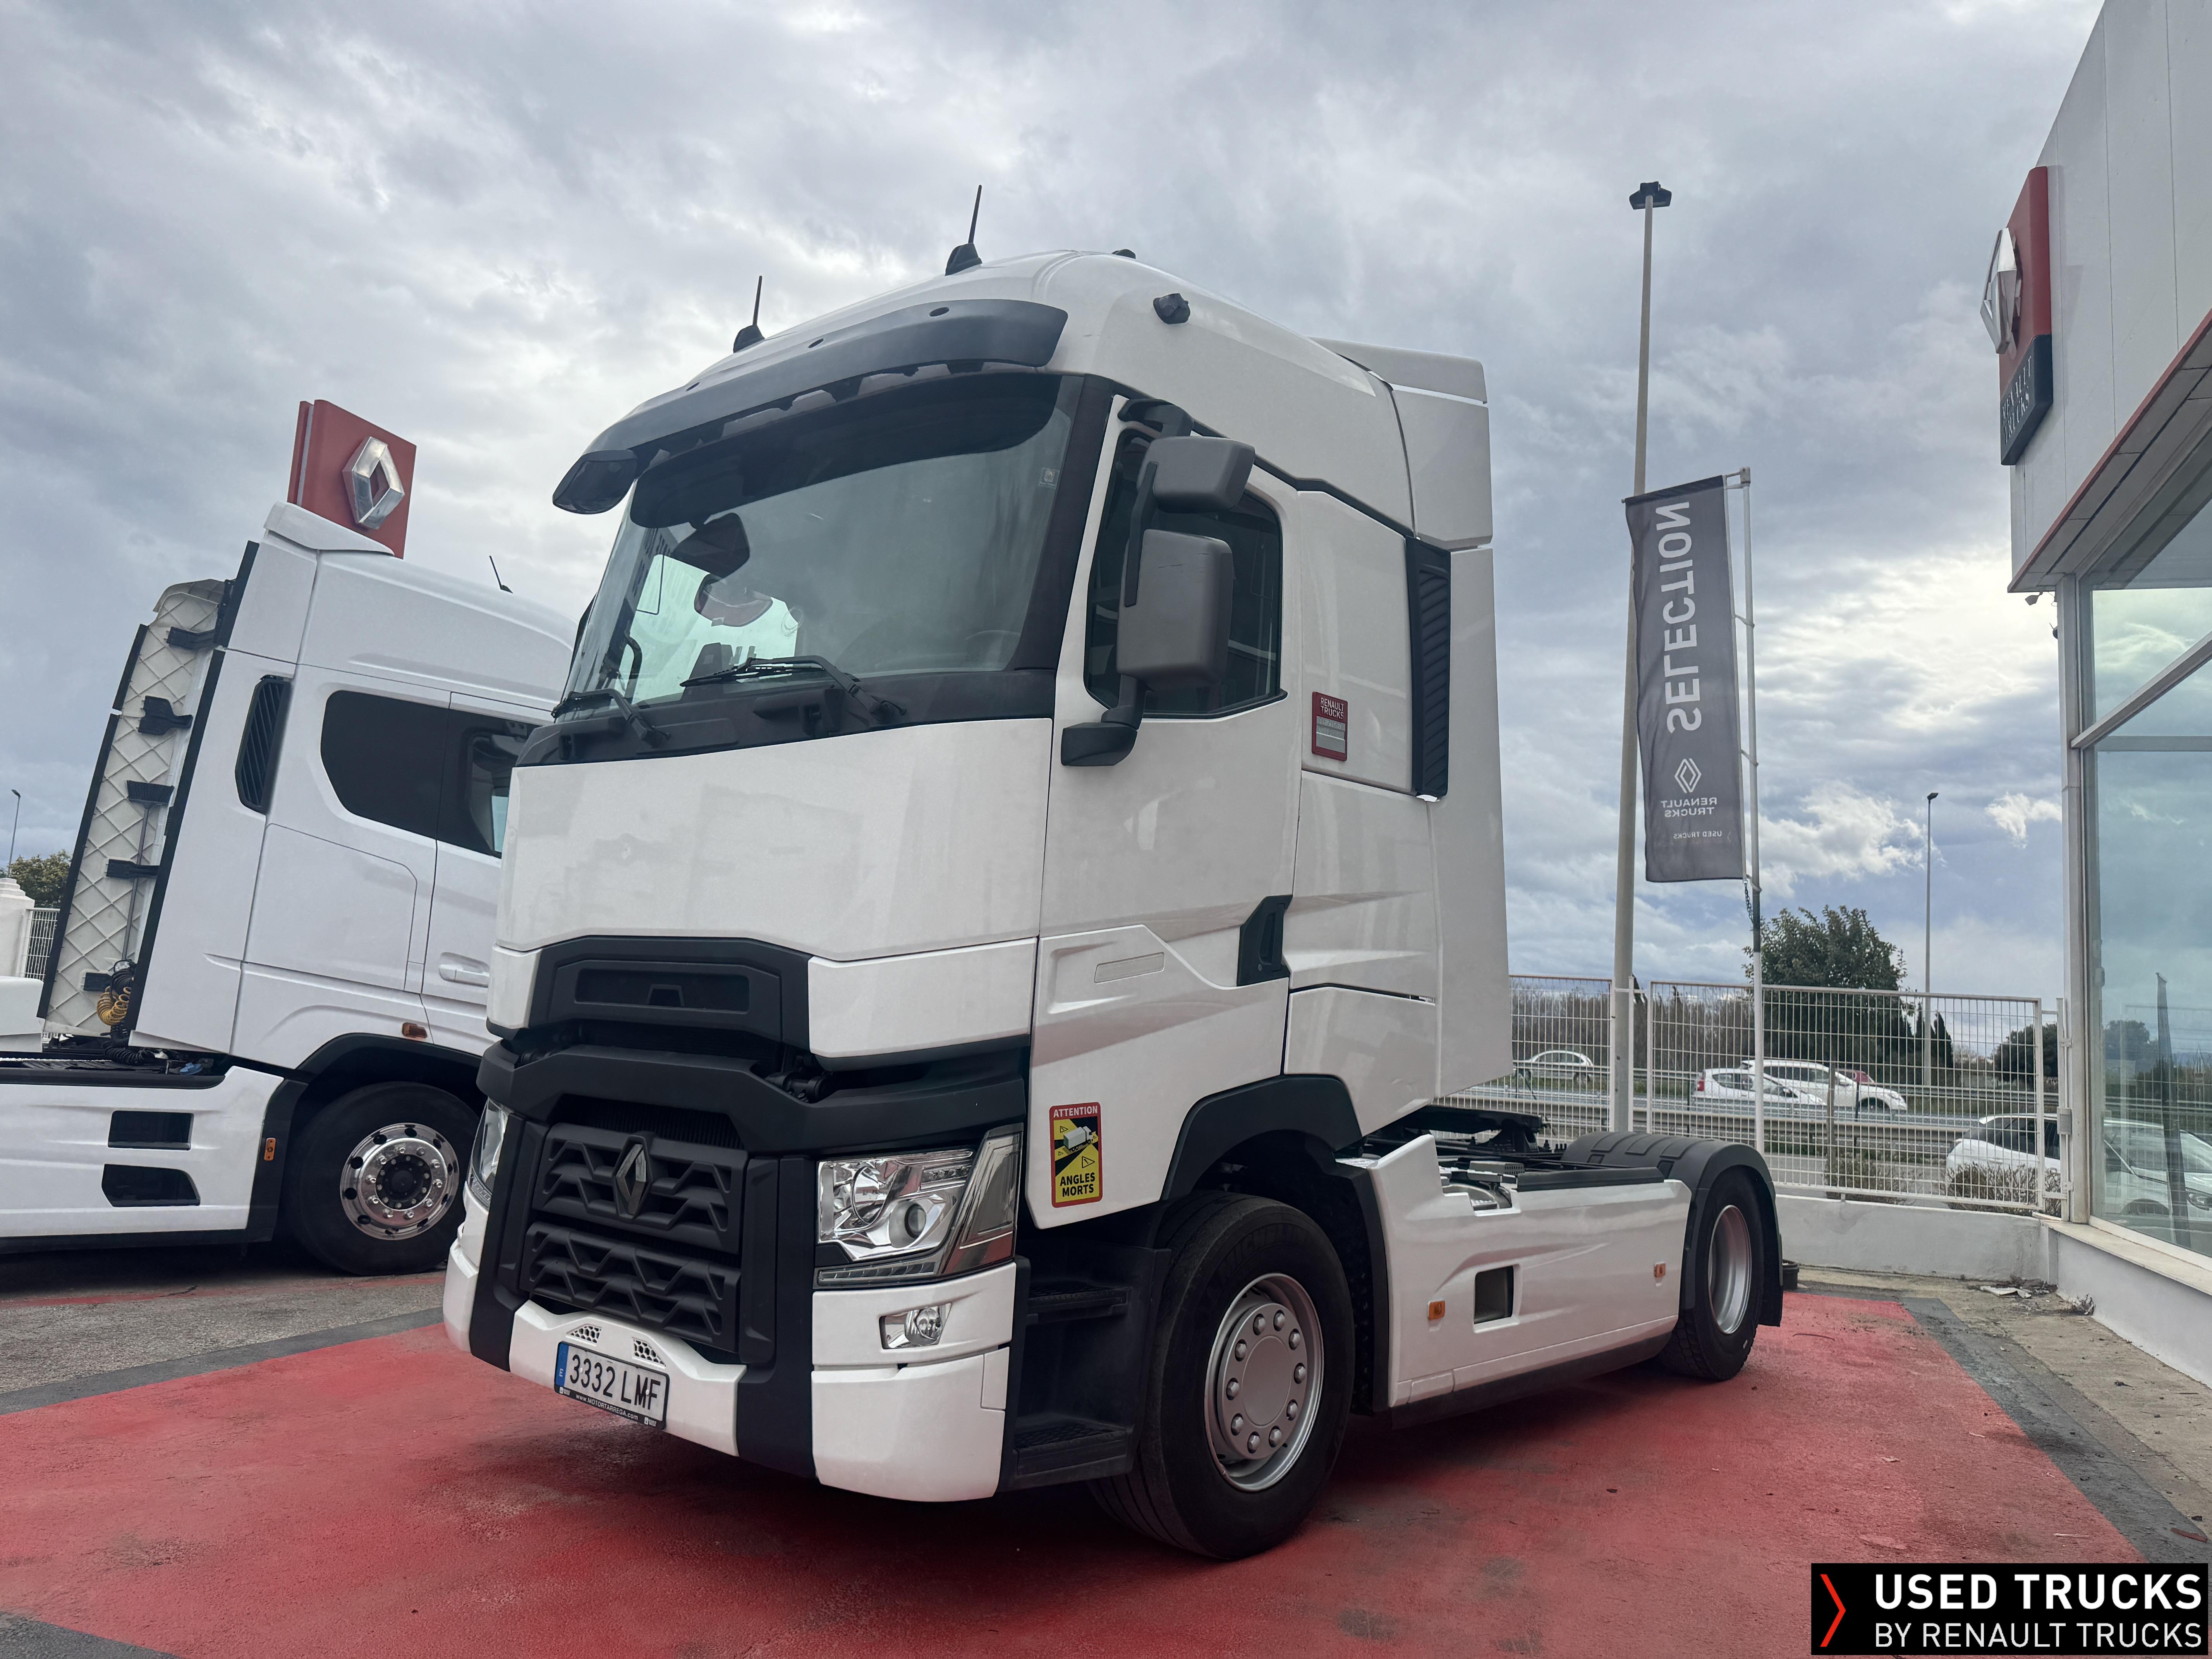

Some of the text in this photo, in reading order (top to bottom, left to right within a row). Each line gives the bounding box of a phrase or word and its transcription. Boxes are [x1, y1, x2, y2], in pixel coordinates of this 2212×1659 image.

[1320, 697, 1344, 712] RENAULT
[1321, 706, 1344, 720] TRUCKS
[1053, 1105, 1098, 1118] ATTENTION
[1060, 1172, 1096, 1187] ANGLES
[1062, 1183, 1094, 1197] MORTS
[559, 1368, 564, 1377] E
[570, 1354, 661, 1410] 3332 LMF
[575, 1394, 639, 1421] www.MOTORTARREGA.com
